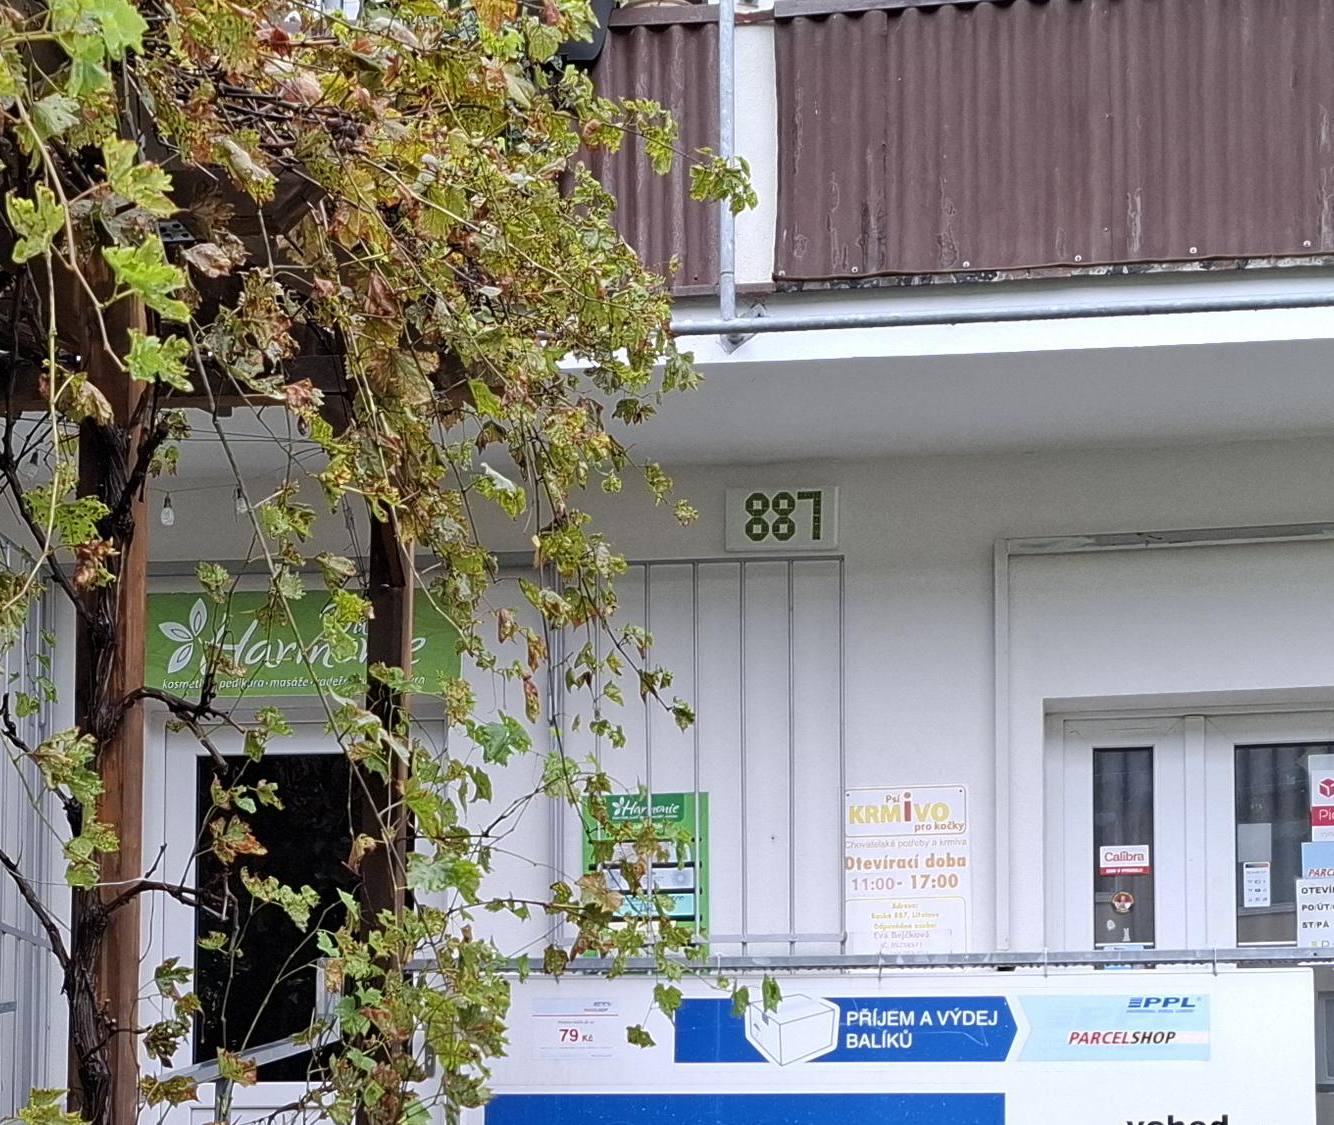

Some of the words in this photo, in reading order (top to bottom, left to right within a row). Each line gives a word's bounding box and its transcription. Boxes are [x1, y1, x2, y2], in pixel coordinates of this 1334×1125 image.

[745, 490, 822, 542] 887
[200, 612, 427, 676] Harme
[914, 823, 932, 833] pro
[934, 821, 965, 832] kočky
[844, 854, 919, 871] Otevírací
[925, 852, 967, 868] doba
[1104, 851, 1145, 862] Calibra
[910, 873, 959, 890] 17:00
[1143, 996, 1196, 1008] PPL
[846, 1007, 915, 1027] PŘÍJEM
[919, 1010, 933, 1027] A
[936, 1007, 998, 1027] VÝDEJ
[559, 1028, 579, 1043] 79
[845, 1029, 913, 1049] BALÍKŮ
[1068, 1031, 1176, 1045] PARCELSHOP
